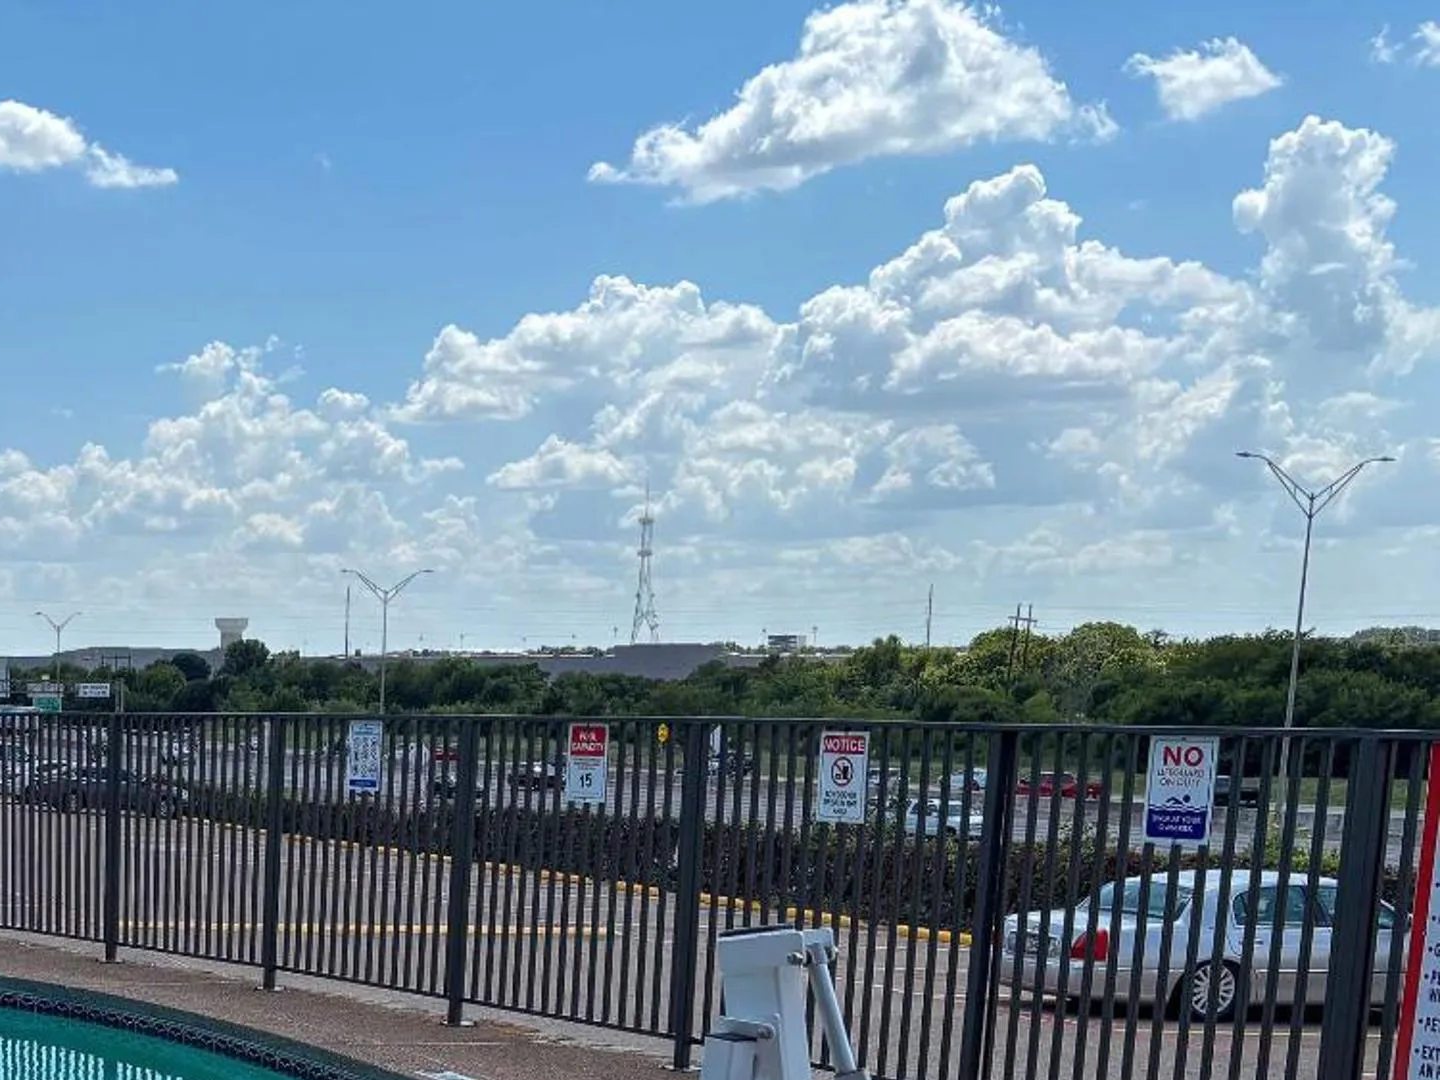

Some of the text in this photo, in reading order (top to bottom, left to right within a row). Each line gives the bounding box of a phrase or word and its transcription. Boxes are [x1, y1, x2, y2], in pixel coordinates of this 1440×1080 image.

[824, 737, 865, 752] NOTICE
[1163, 746, 1203, 766] NO
[580, 773, 592, 788] 15
